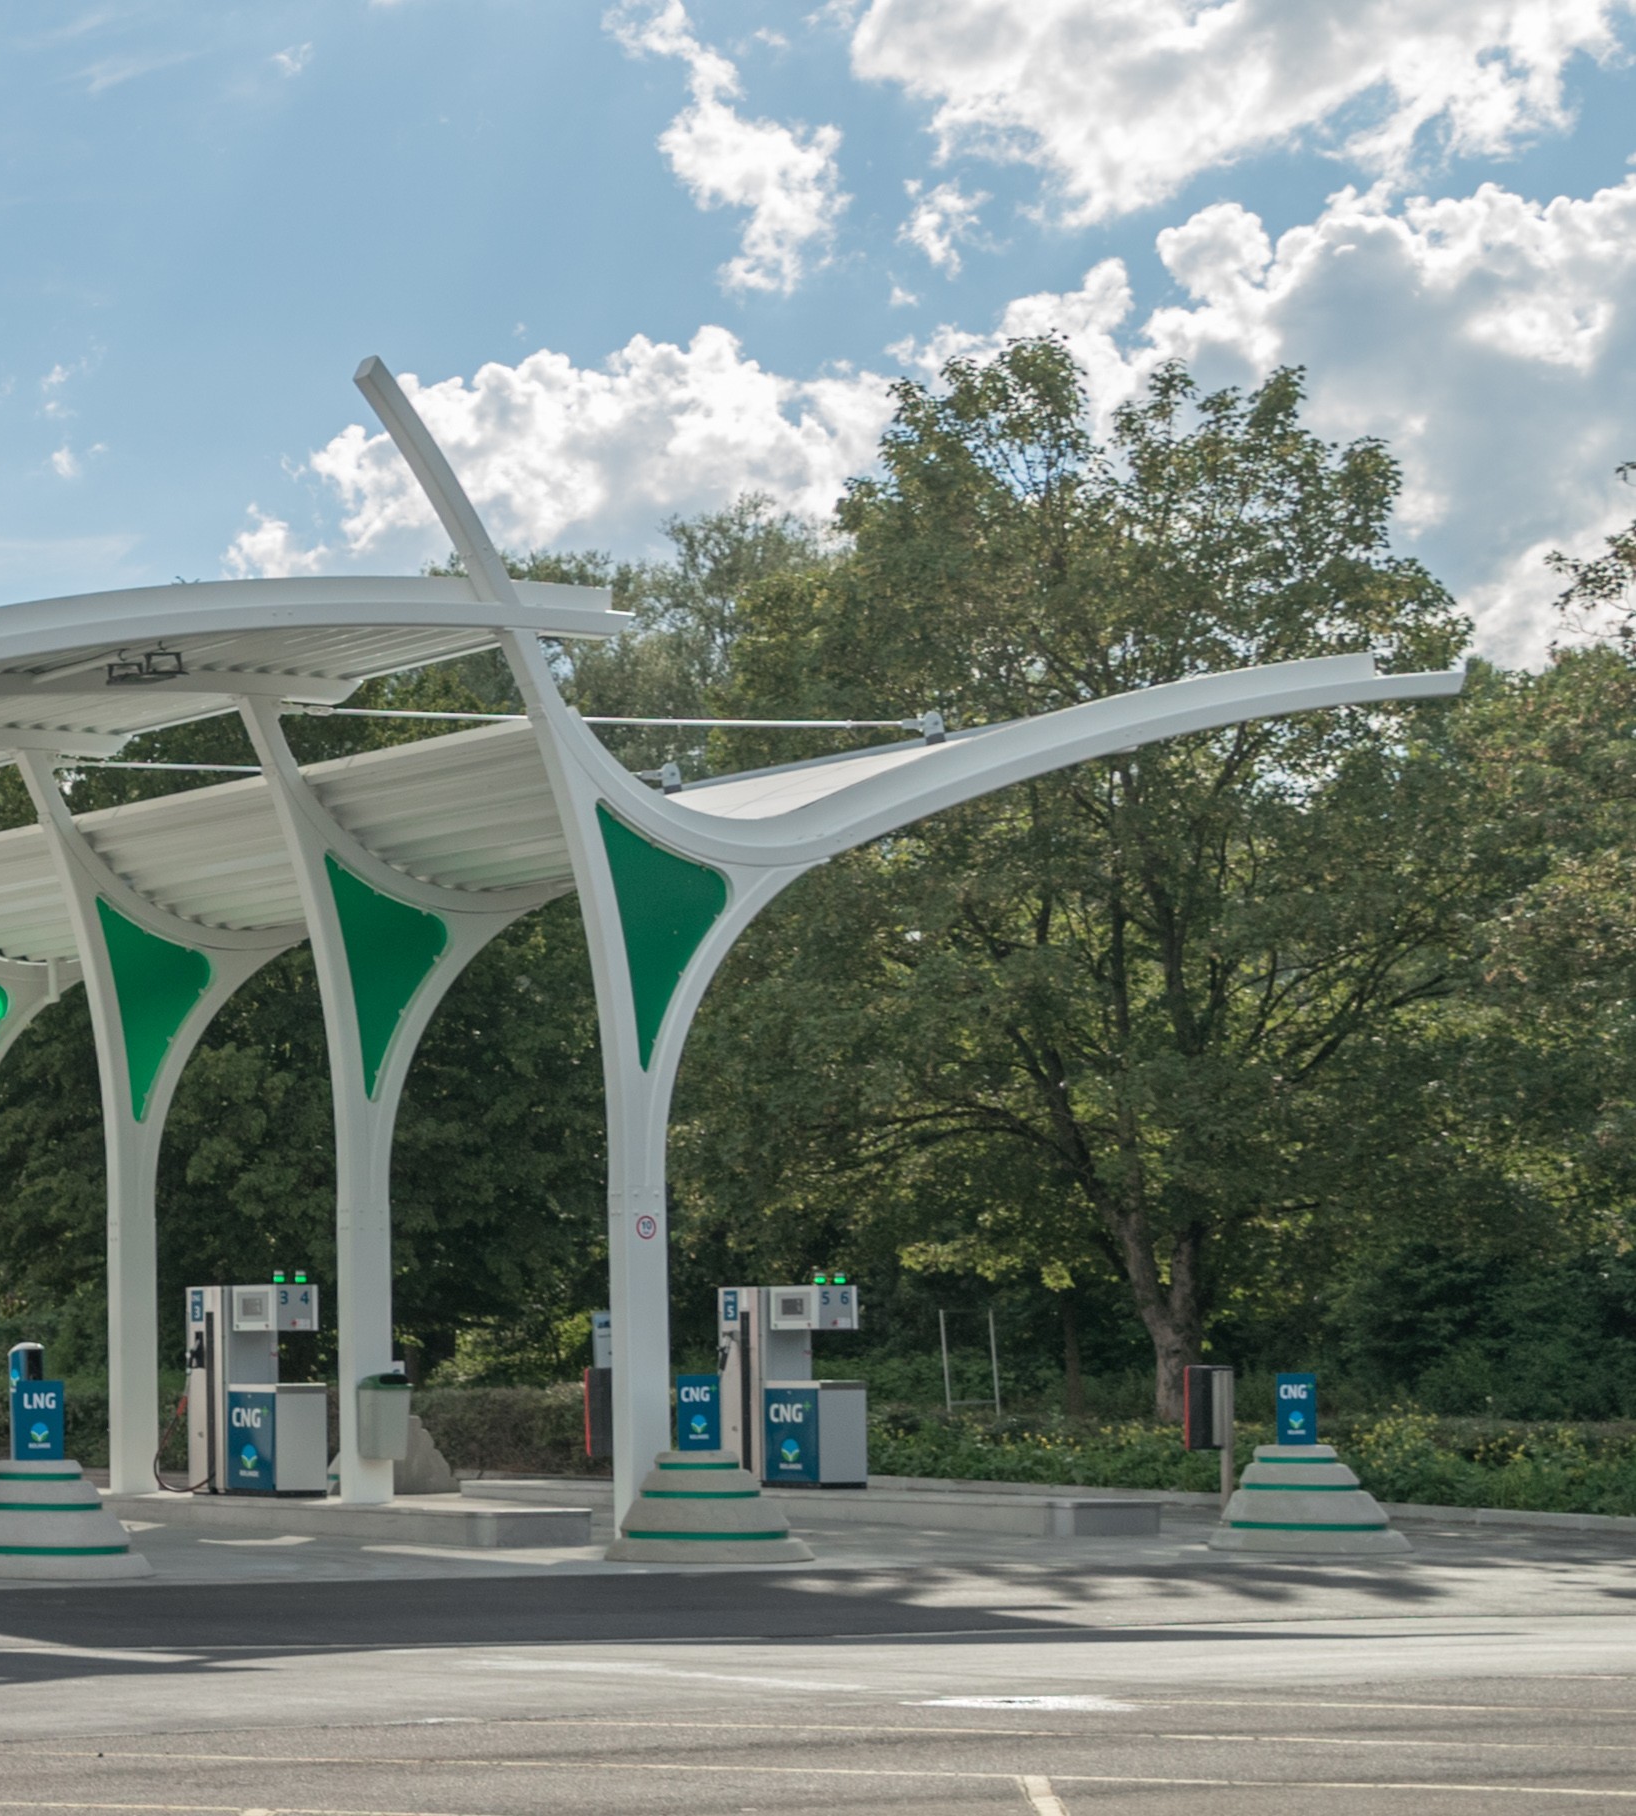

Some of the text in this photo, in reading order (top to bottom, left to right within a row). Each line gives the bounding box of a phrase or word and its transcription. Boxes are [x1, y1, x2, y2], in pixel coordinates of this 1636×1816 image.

[279, 1290, 310, 1305] 3 4
[822, 1291, 850, 1305] 5 6
[193, 1305, 201, 1319] 3
[727, 1305, 735, 1318] 5
[23, 1392, 57, 1410] LNG
